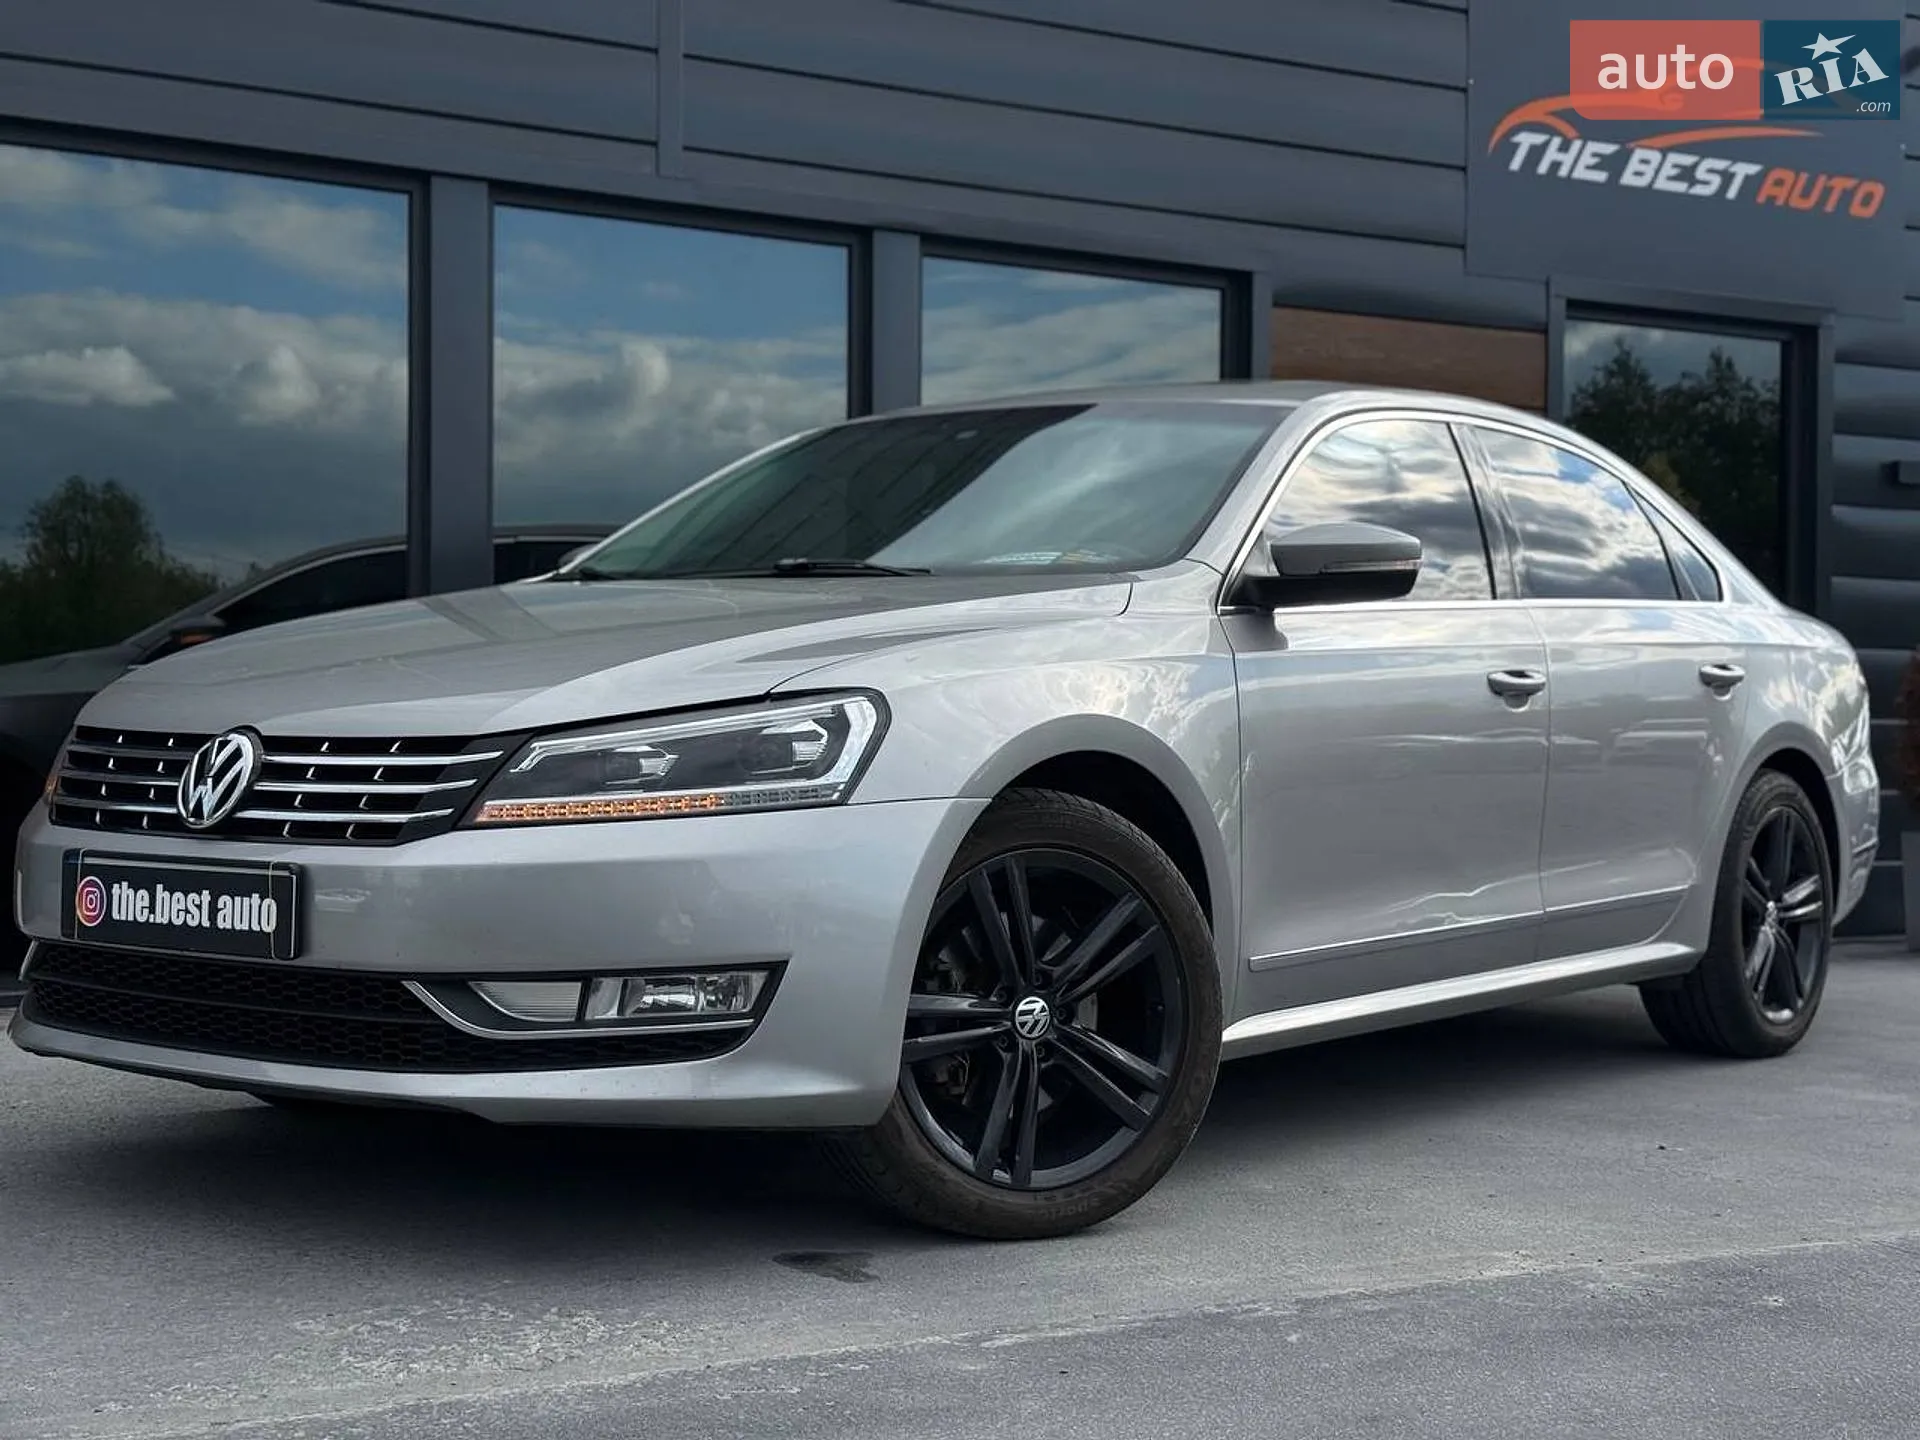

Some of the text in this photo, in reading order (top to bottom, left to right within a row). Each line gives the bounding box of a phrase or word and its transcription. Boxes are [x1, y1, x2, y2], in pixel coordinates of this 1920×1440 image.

[1508, 131, 1886, 219] THE BEST AUTO
[111, 881, 278, 933] the.best auto
